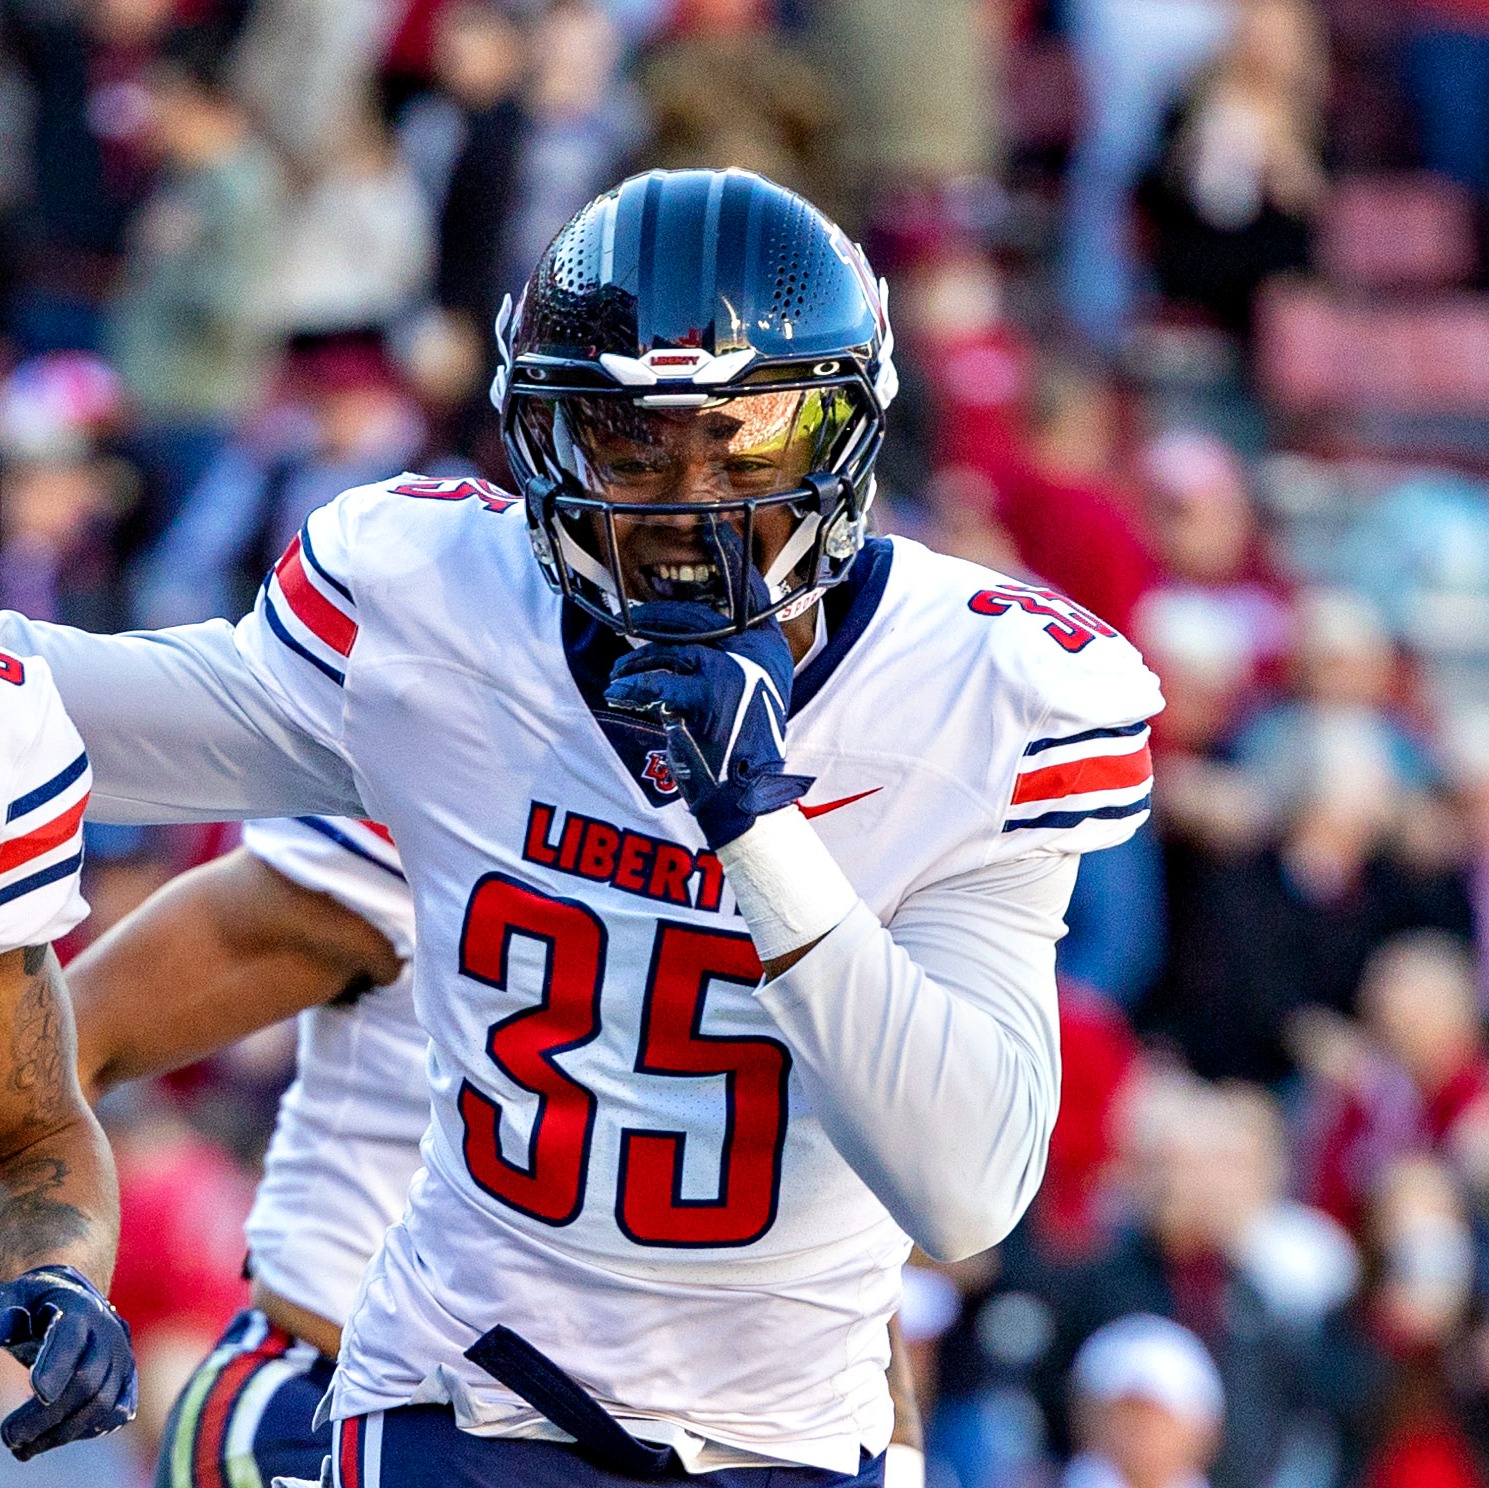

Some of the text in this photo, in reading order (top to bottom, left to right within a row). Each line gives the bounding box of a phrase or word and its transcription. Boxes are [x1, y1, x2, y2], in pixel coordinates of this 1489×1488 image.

[650, 355, 700, 366] LIBERTY
[522, 800, 744, 916] LIBERT
[457, 871, 793, 1249] 35
